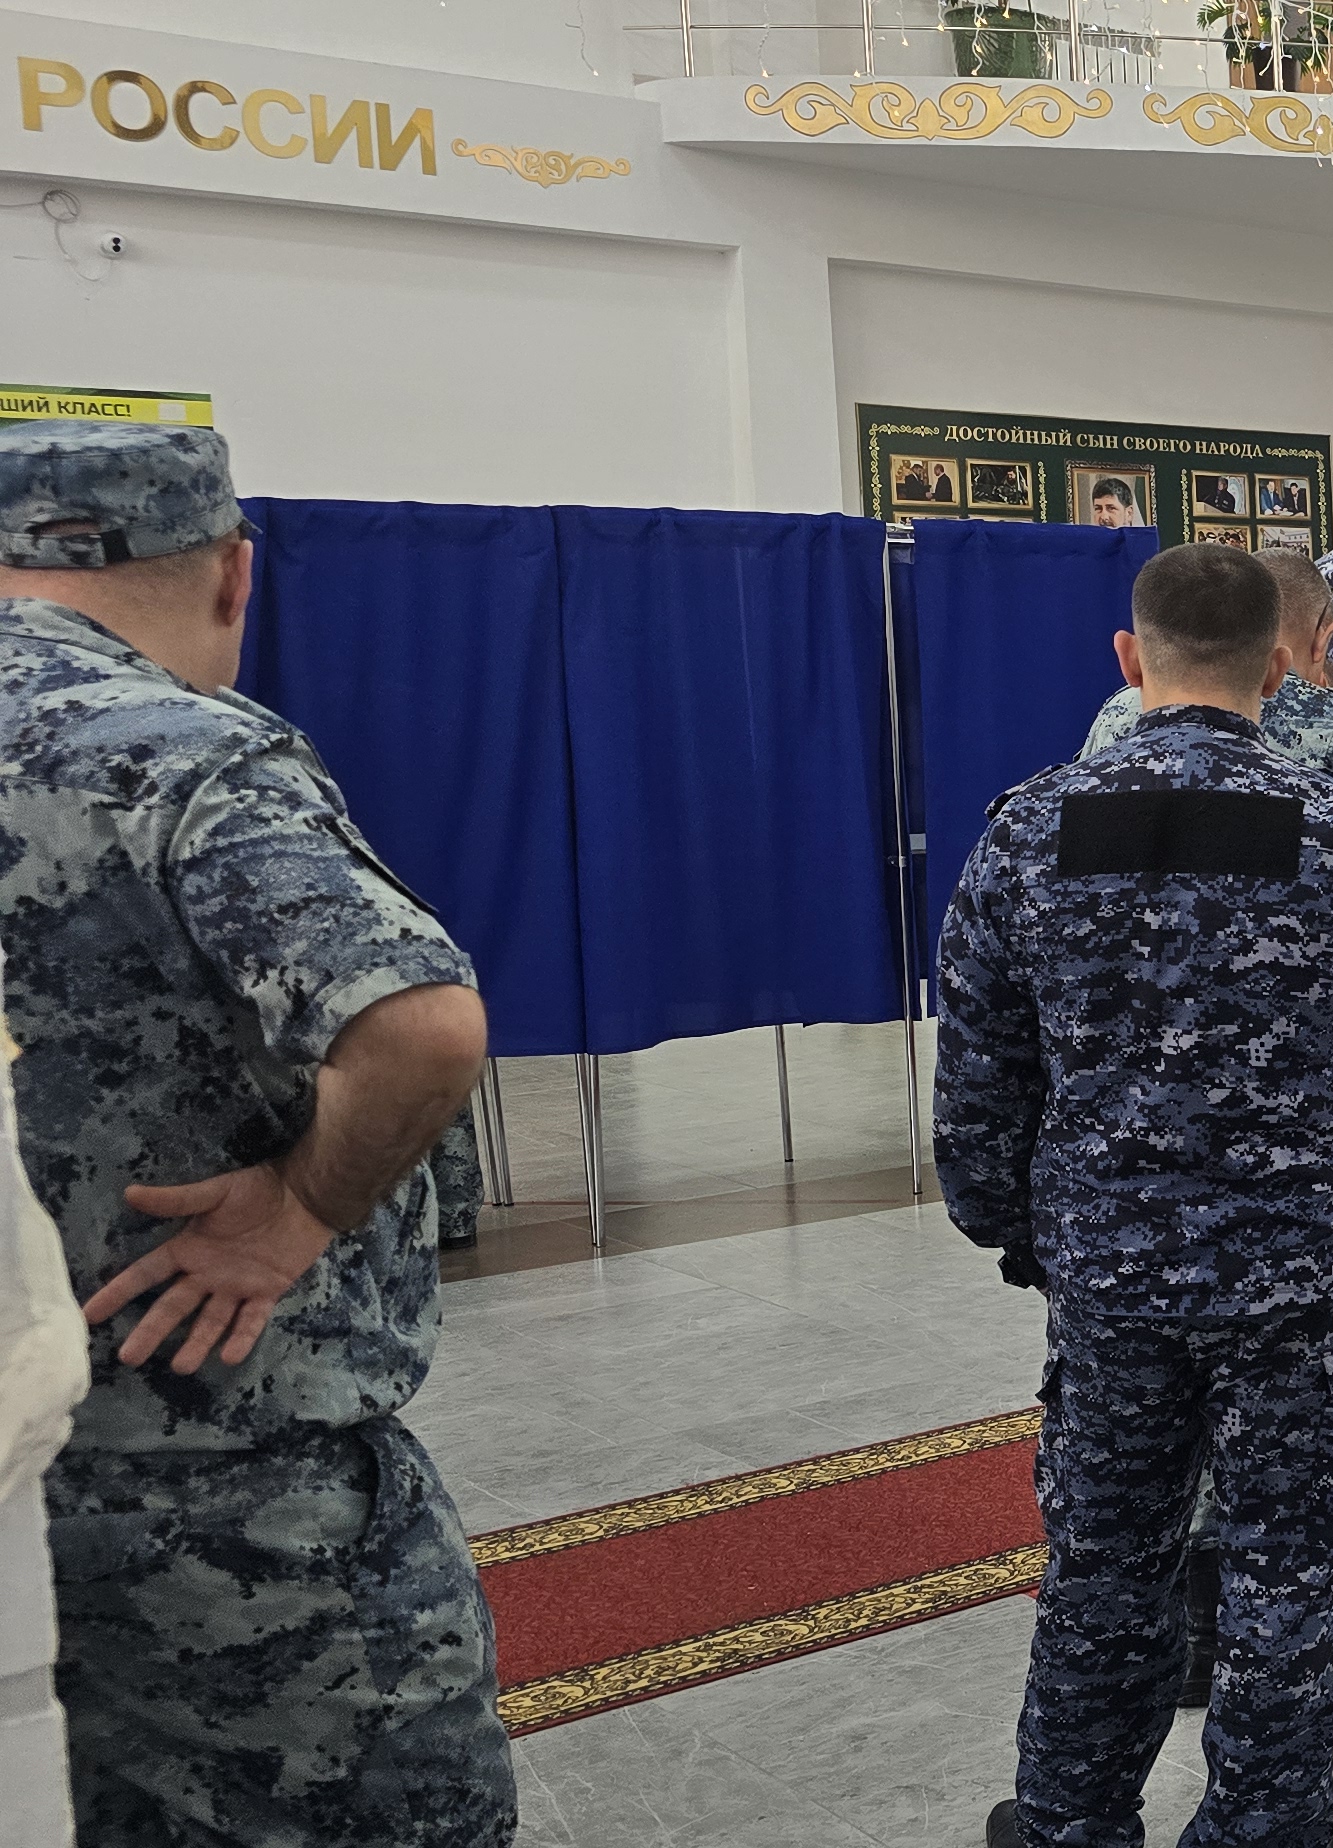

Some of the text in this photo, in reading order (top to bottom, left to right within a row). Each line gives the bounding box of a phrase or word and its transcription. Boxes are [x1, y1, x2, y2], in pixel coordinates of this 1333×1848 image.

[17, 56, 437, 176] РОССИИ
[57, 400, 131, 417] КЛАСС!
[944, 425, 1263, 459] ДОСТОЙНЫЙ СЫН СВОЕГО НАРОДА
